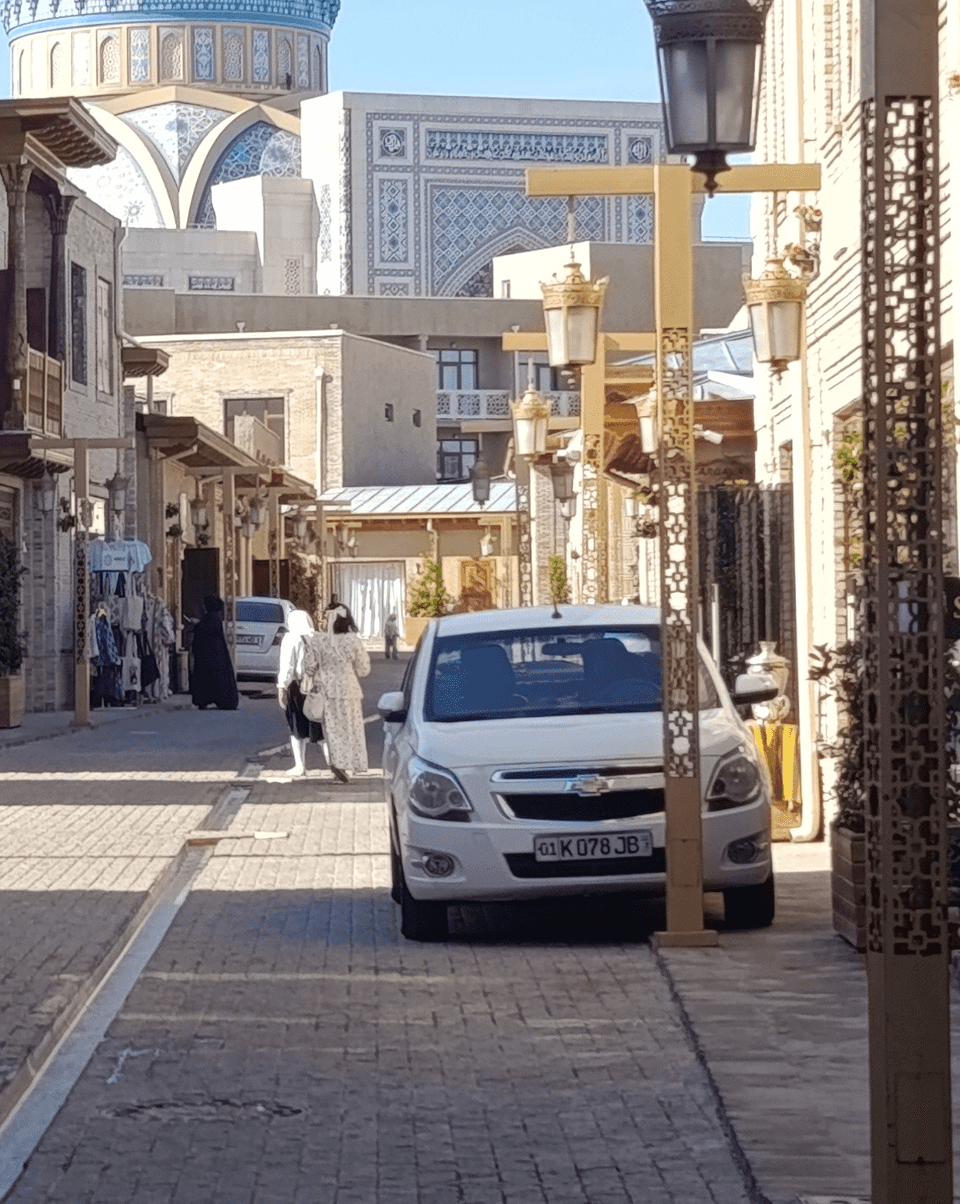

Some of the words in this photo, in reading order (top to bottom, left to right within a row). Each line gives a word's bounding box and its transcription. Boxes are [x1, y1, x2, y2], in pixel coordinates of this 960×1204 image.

[539, 842, 557, 856] 01
[561, 839, 573, 857] K
[576, 837, 611, 857] 078
[614, 836, 640, 855] JB
